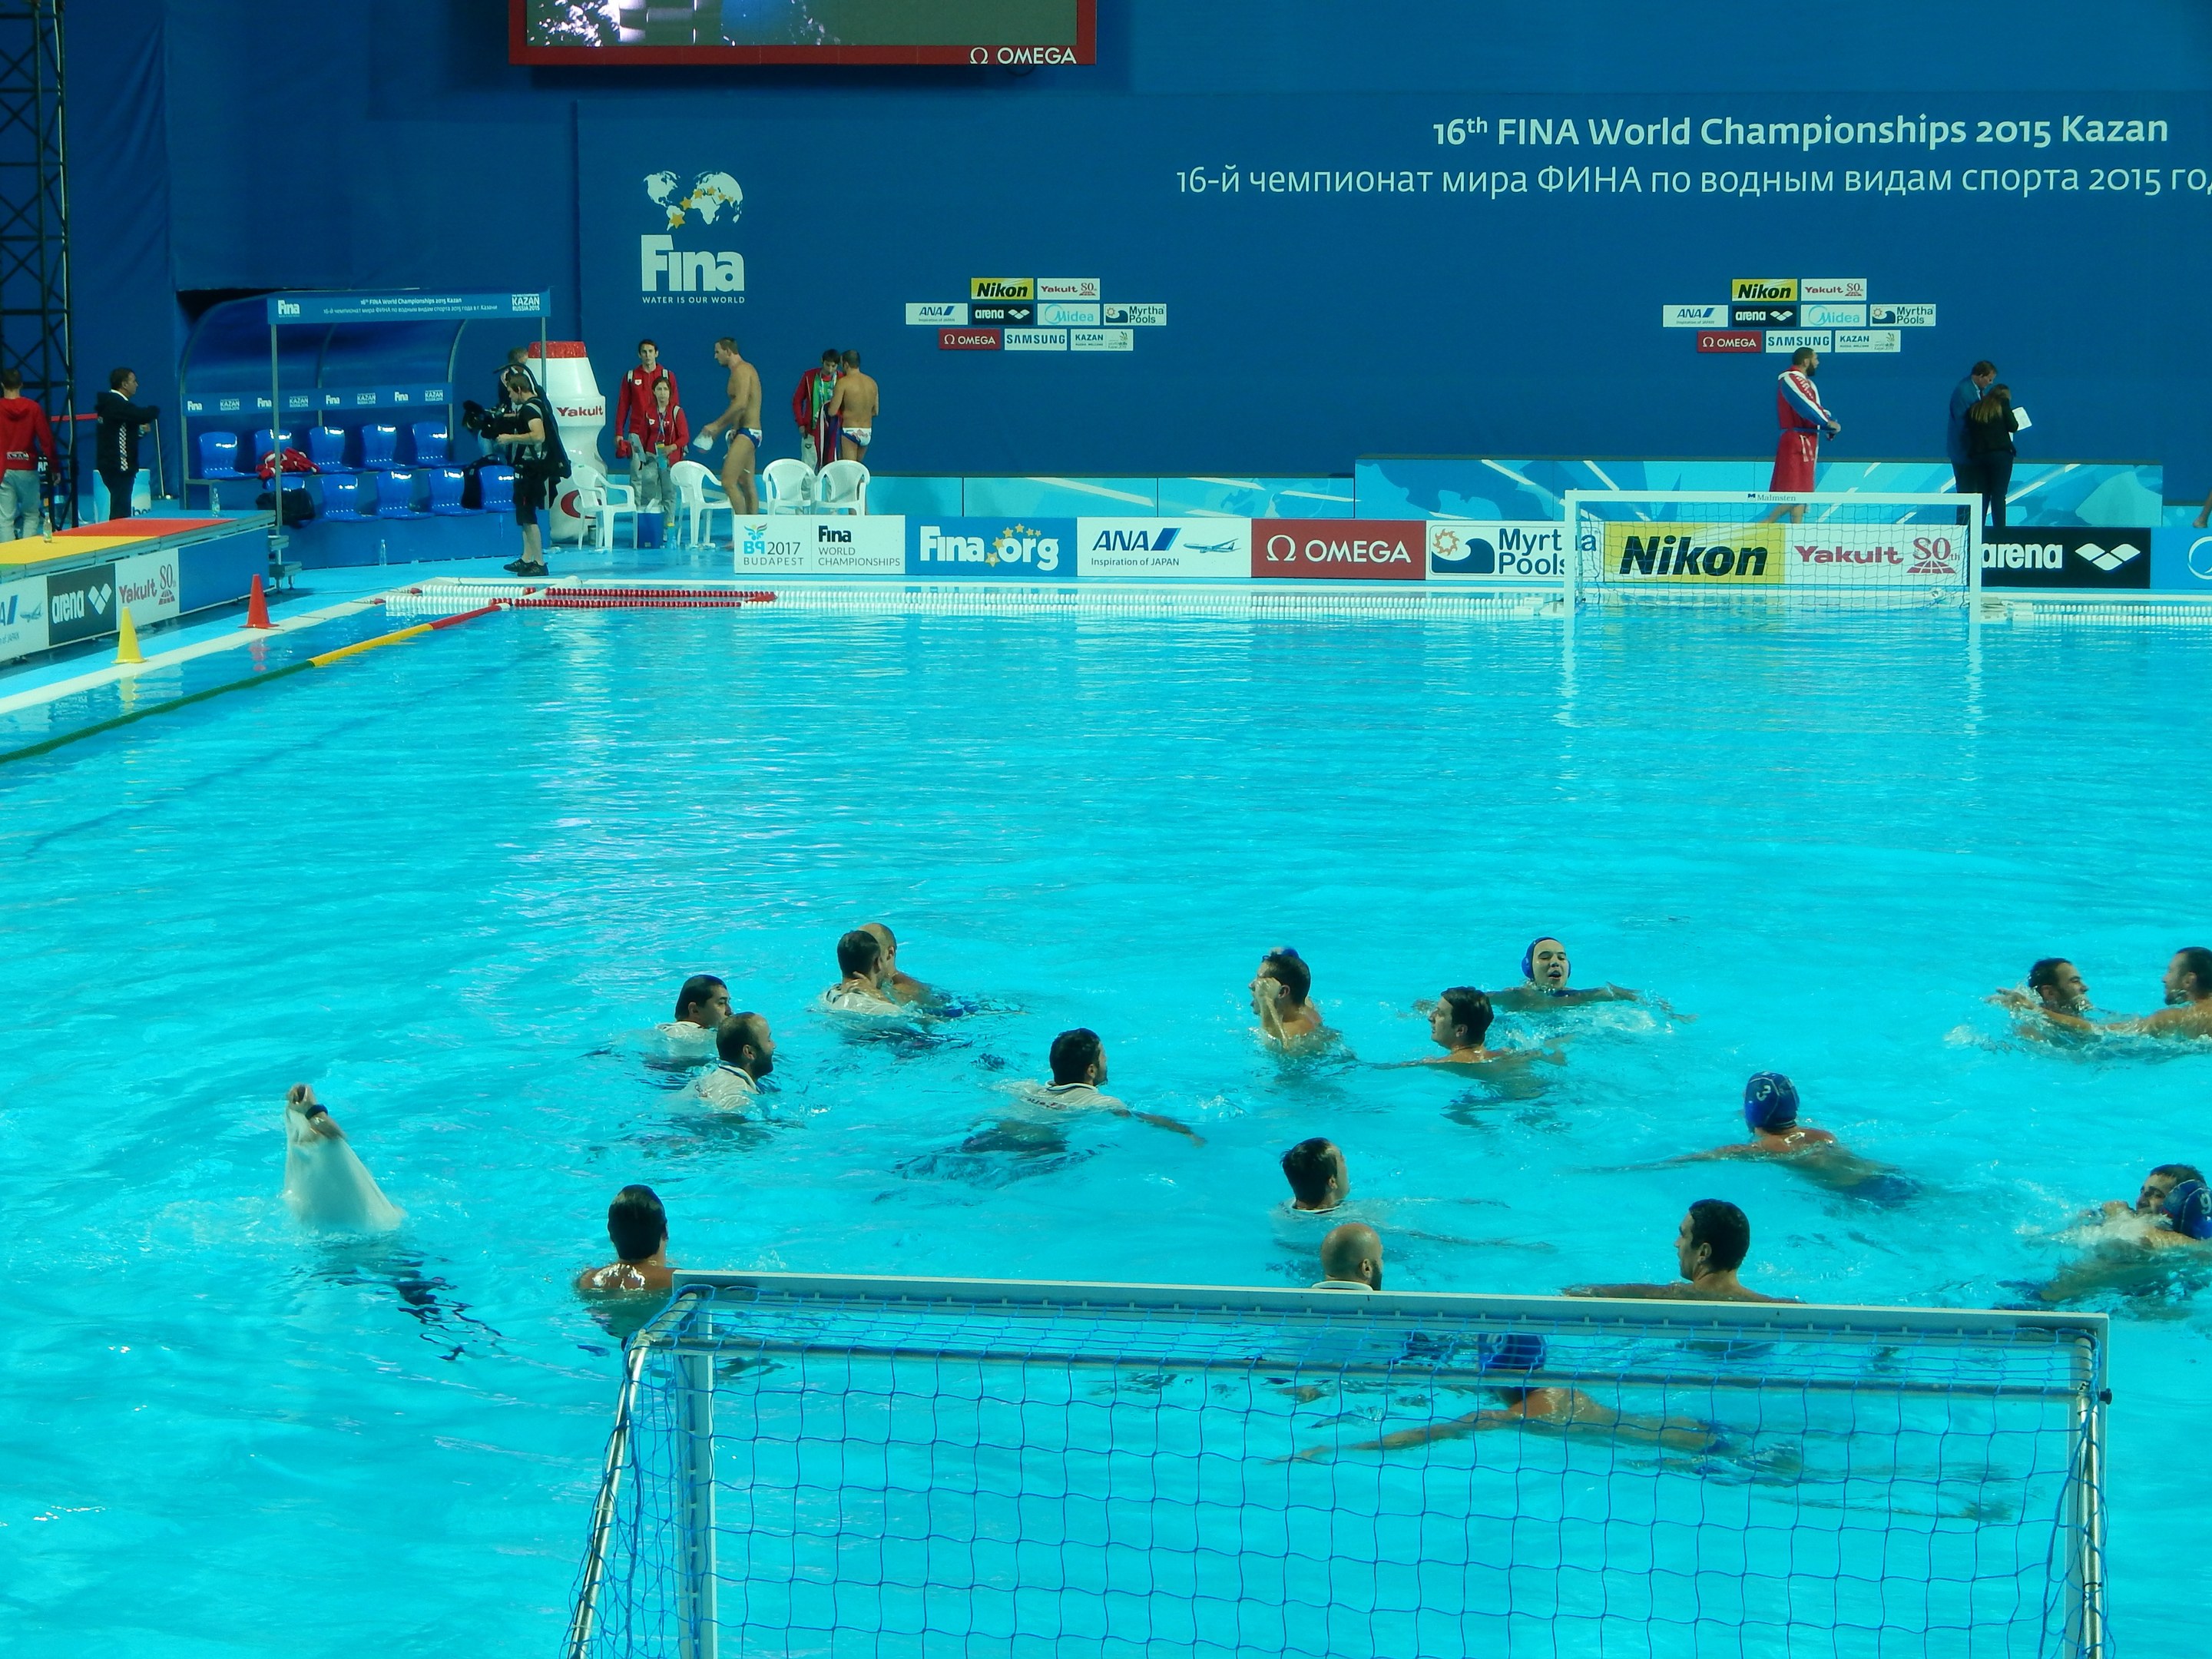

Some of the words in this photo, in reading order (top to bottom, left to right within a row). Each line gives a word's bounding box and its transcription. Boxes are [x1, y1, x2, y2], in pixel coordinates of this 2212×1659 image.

[998, 47, 1077, 65] OMEGA
[1432, 116, 1488, 145] 16th
[1498, 118, 1579, 145] FINA
[1588, 117, 1690, 145] World
[1700, 114, 1966, 151] Championships
[1976, 120, 2051, 147] 2015
[2062, 115, 2167, 142] Kazan
[1177, 164, 1239, 193] 16-й
[1250, 171, 1433, 193] чемпионат
[1442, 171, 1527, 200] мира
[1538, 165, 1642, 193] ФИНА
[1651, 171, 1690, 193] по
[1701, 171, 1833, 197] водным
[1846, 169, 1951, 196] видам
[1962, 168, 2079, 198] спорта
[2089, 168, 2161, 196] 2015
[641, 234, 745, 292] Fina
[977, 283, 1028, 297] Nikon
[1738, 283, 1791, 298] Nikon
[512, 296, 540, 306] KAZAN
[277, 300, 300, 315] Fina
[919, 306, 942, 316] ANA
[1129, 306, 1164, 318] Myrtha
[1677, 309, 1702, 318] ANA
[1896, 306, 1933, 319] Myrtha
[975, 309, 1004, 320] arena
[1054, 310, 1094, 322] Midea
[1129, 315, 1156, 323] Pools
[1735, 311, 1766, 321] arena
[1817, 312, 1860, 323] Midea
[1896, 316, 1925, 324] Pools
[958, 336, 995, 345] OMEGA
[1006, 334, 1065, 345] SAMSUNG
[1717, 338, 1757, 347] OMEGA
[1768, 336, 1830, 346] SAMSUNG
[257, 397, 272, 408] Fina
[326, 395, 340, 405] Fina
[394, 392, 409, 402] Fina
[187, 400, 202, 411] Fina
[557, 406, 603, 417] Yakult
[818, 525, 852, 543] Fina
[1092, 530, 1149, 551] ANA
[1498, 528, 1597, 556] Myrta
[767, 541, 801, 555] 2017
[818, 547, 856, 555] WORLD
[1305, 539, 1412, 563] OMEGA
[743, 557, 804, 566] BUDAPEST
[1619, 535, 1768, 577] Nikon
[1794, 546, 1904, 565] Yakult
[1981, 543, 2063, 569] arena
[818, 558, 900, 566] CHAMPIONSHIPS
[1091, 557, 1138, 567] Inspiration
[1140, 557, 1149, 566] of
[1151, 558, 1180, 566] JAPAN
[119, 578, 157, 604] Yakult
[51, 589, 84, 624] arena
[1756, 1084, 1771, 1101] 3
[2200, 1193, 2212, 1215] 9
